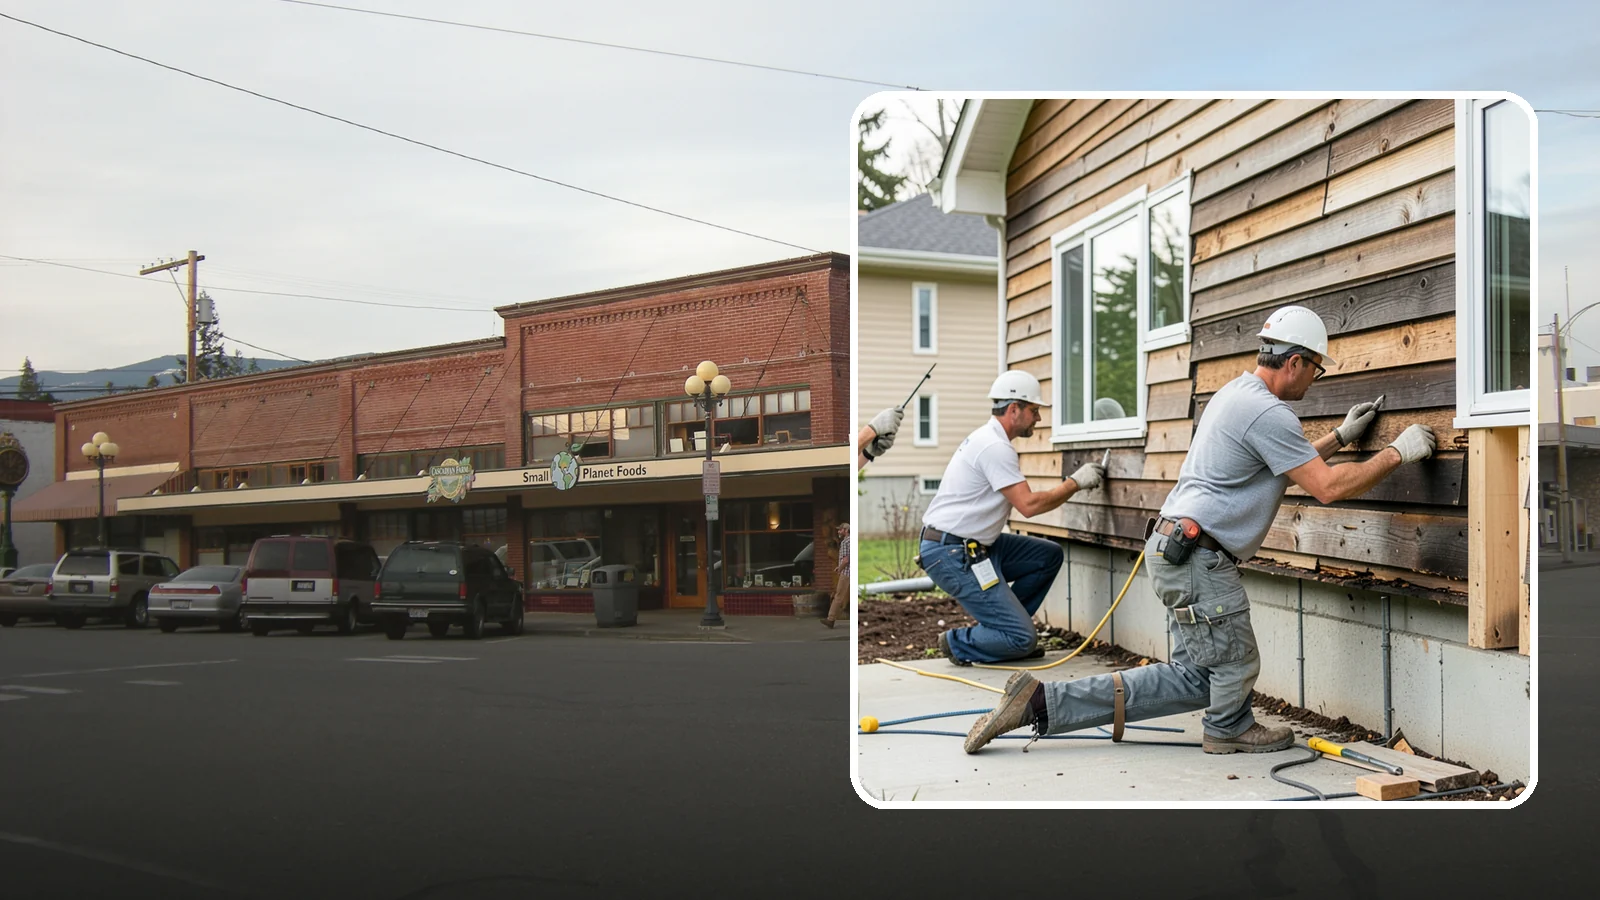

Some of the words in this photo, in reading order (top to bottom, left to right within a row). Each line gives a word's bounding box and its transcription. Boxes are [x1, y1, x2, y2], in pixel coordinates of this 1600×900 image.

[523, 471, 549, 483] Small
[583, 468, 614, 479] Planet
[617, 464, 647, 477] Foods
